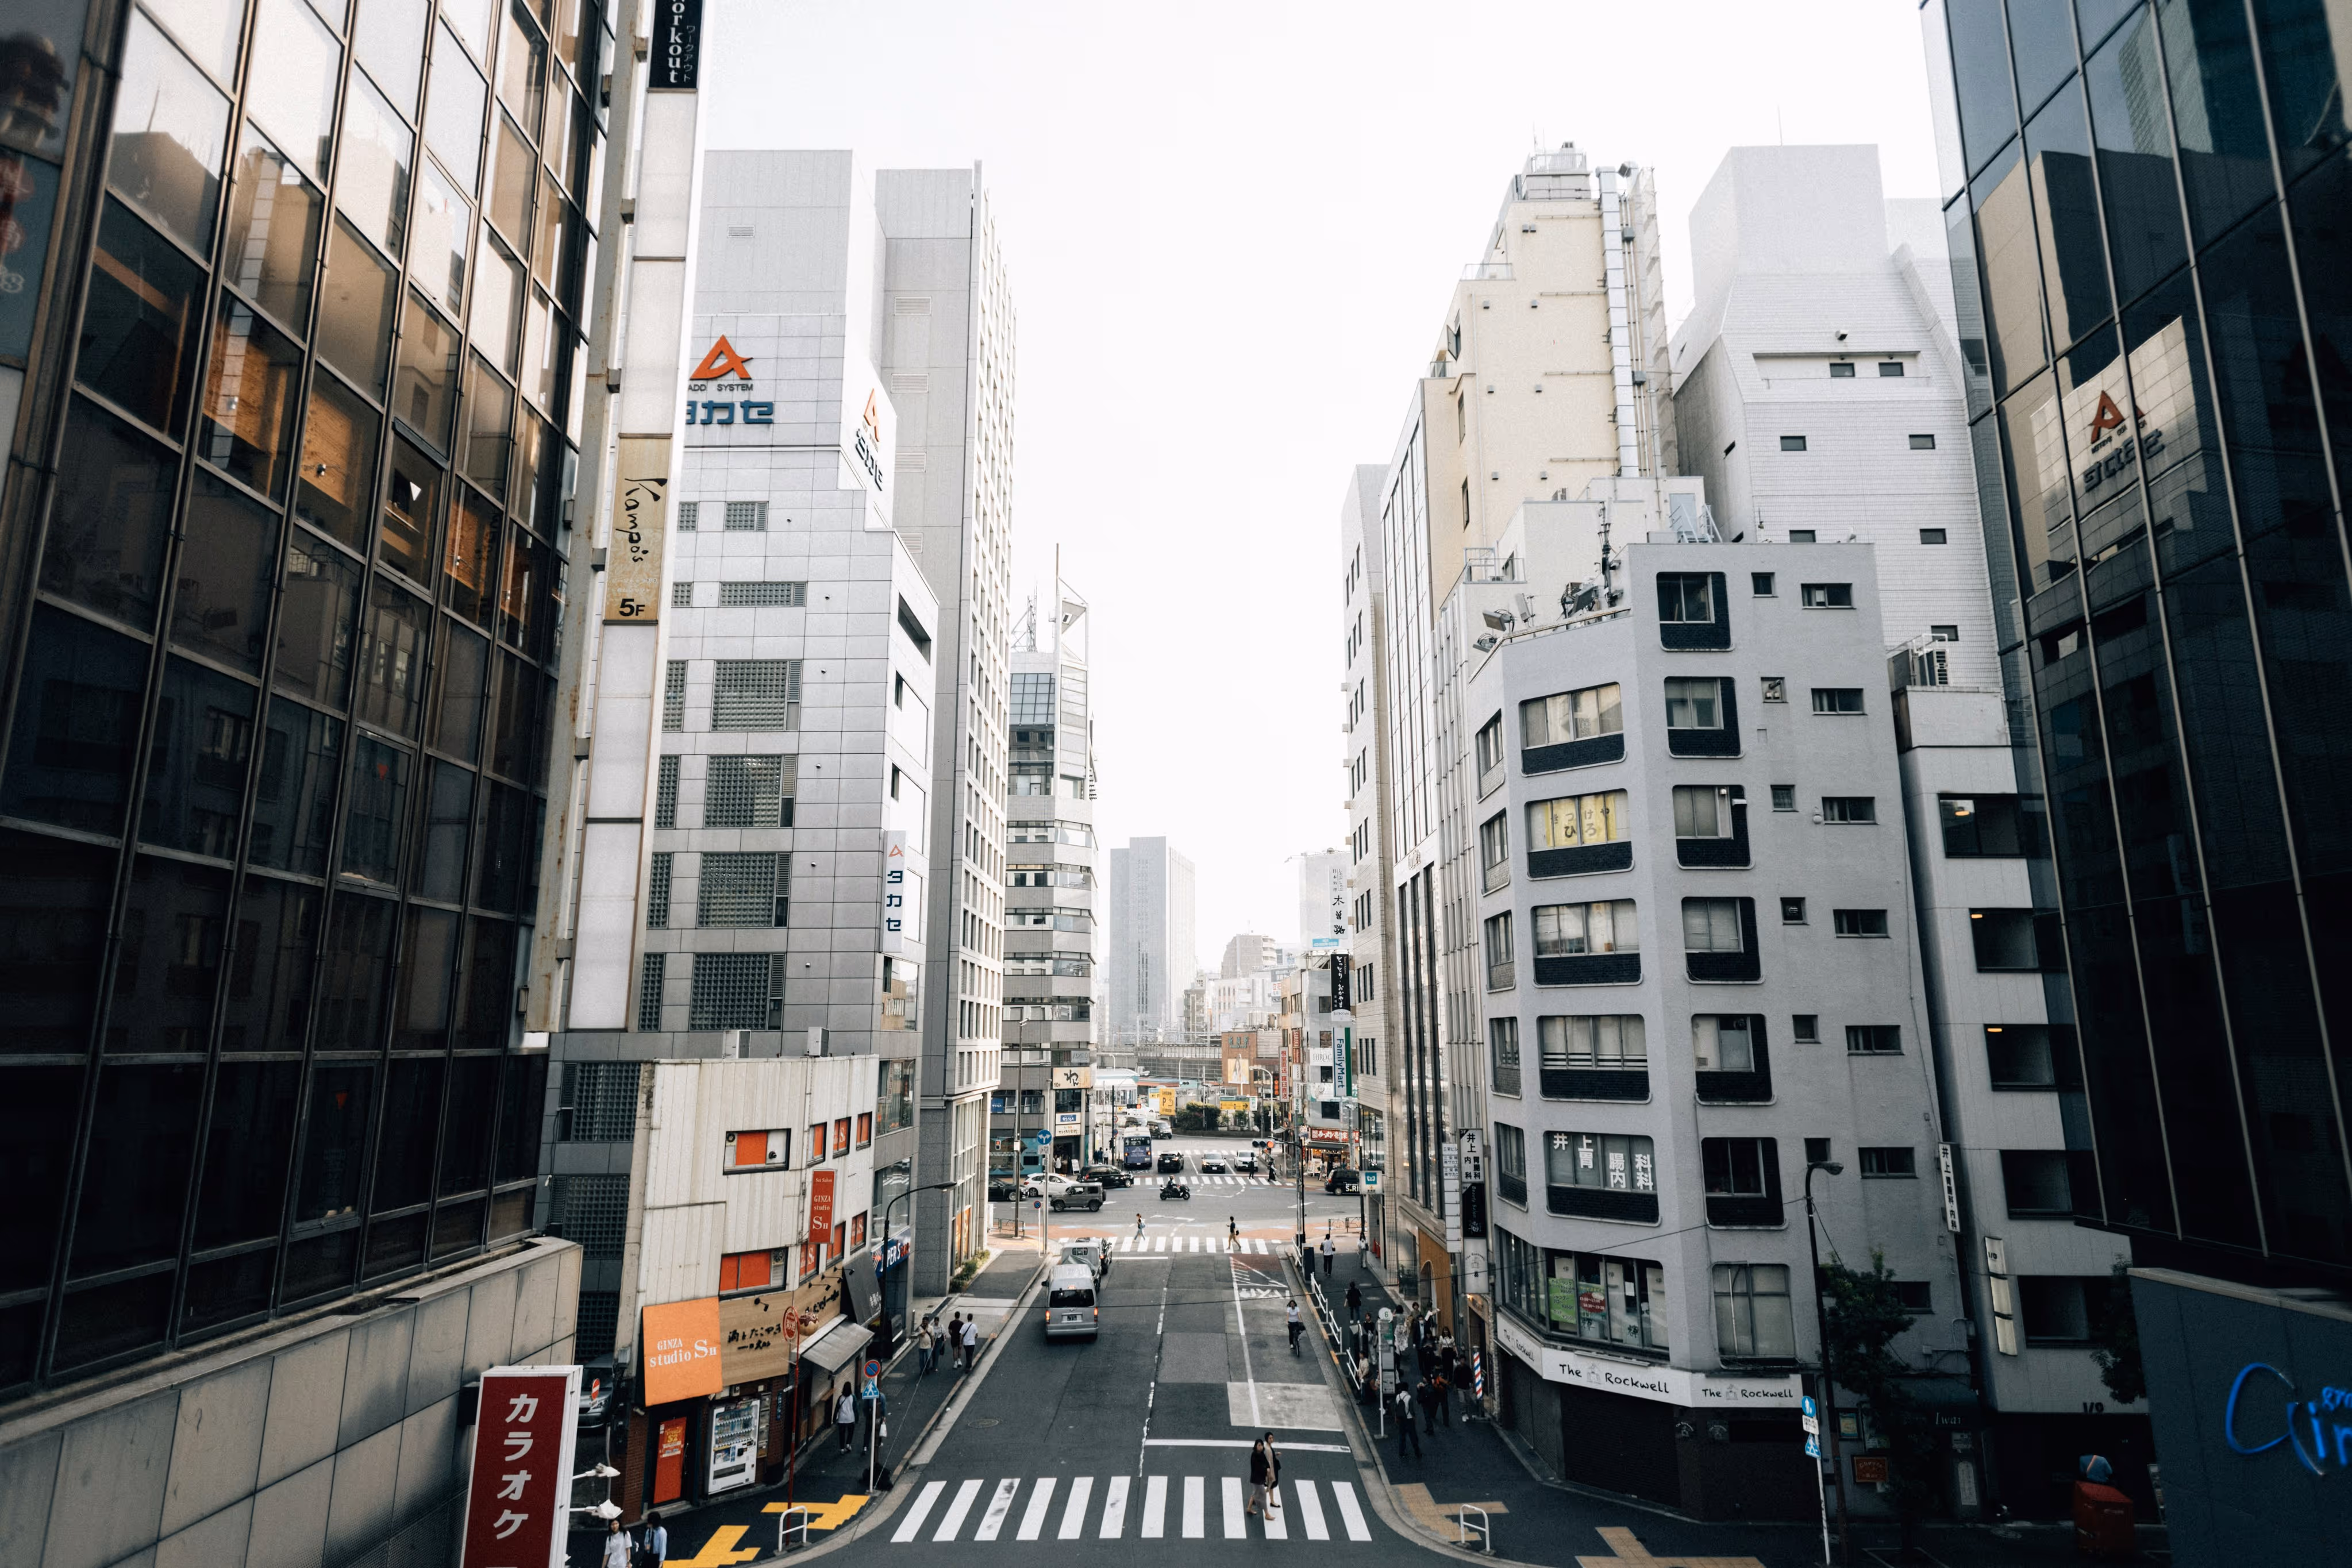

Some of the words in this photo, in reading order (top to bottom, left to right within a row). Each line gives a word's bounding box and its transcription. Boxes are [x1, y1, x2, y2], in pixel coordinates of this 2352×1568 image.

[668, 0, 685, 83] orkout
[684, 25, 695, 82] ワークアウト
[619, 598, 645, 617] 5F
[886, 870, 903, 931] タカセ
[1337, 1038, 1345, 1089] FamilyMart
[1466, 1133, 1476, 1153] 井上
[1464, 1156, 1472, 1180] 内科
[814, 1195, 832, 1203] GINZA
[657, 1338, 683, 1351] GINZA
[1516, 1339, 1535, 1362] Rockwell
[650, 1350, 692, 1367] studio
[1559, 1363, 1582, 1378] The
[1605, 1372, 1669, 1394] Rockwell
[1702, 1389, 1722, 1398] The
[1741, 1389, 1793, 1399] Rockwell
[493, 1393, 539, 1540] カラオケ
